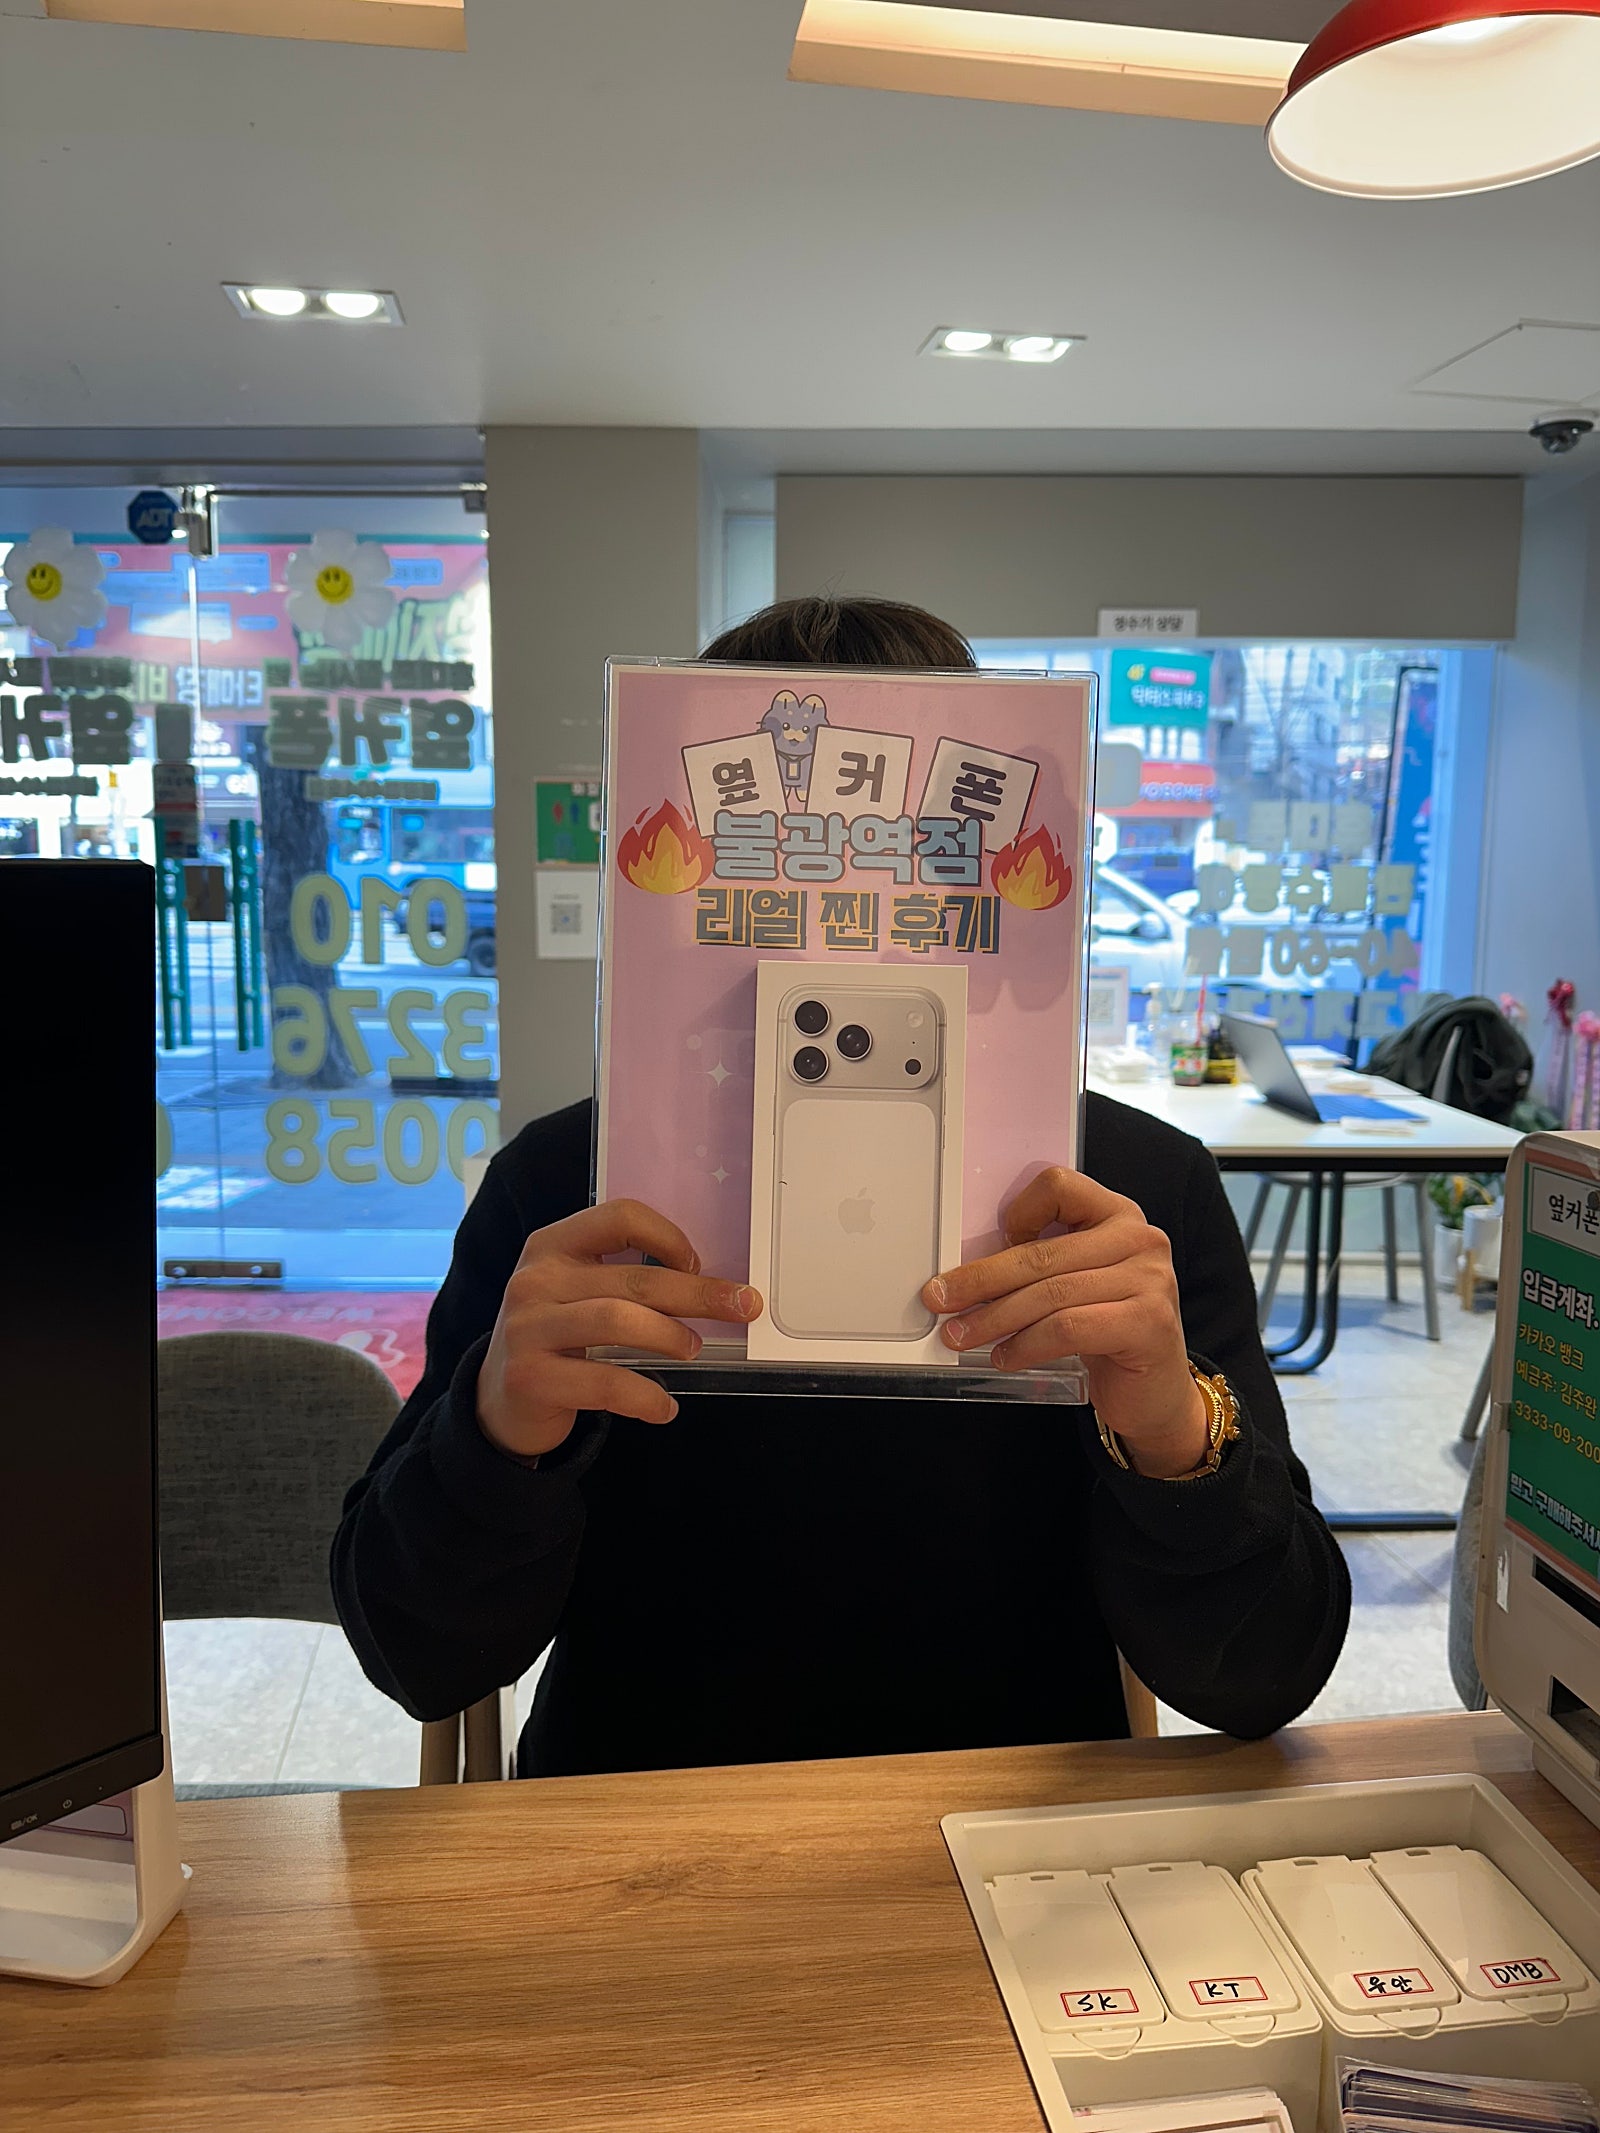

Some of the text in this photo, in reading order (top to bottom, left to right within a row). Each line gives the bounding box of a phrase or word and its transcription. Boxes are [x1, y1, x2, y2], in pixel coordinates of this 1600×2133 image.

[136, 510, 172, 528] ADT
[712, 809, 985, 885] 불광역점
[696, 888, 1000, 953] 리얼 찐 후기
[1519, 1323, 1584, 1371] 카카오 뱅크
[1516, 1360, 1598, 1420] 예금주: 김주완
[1515, 1400, 1600, 1464] 3333-09-200
[1204, 1982, 1241, 1999] KT
[1493, 1962, 1543, 1985] DMB
[1077, 1993, 1118, 2012] SK
